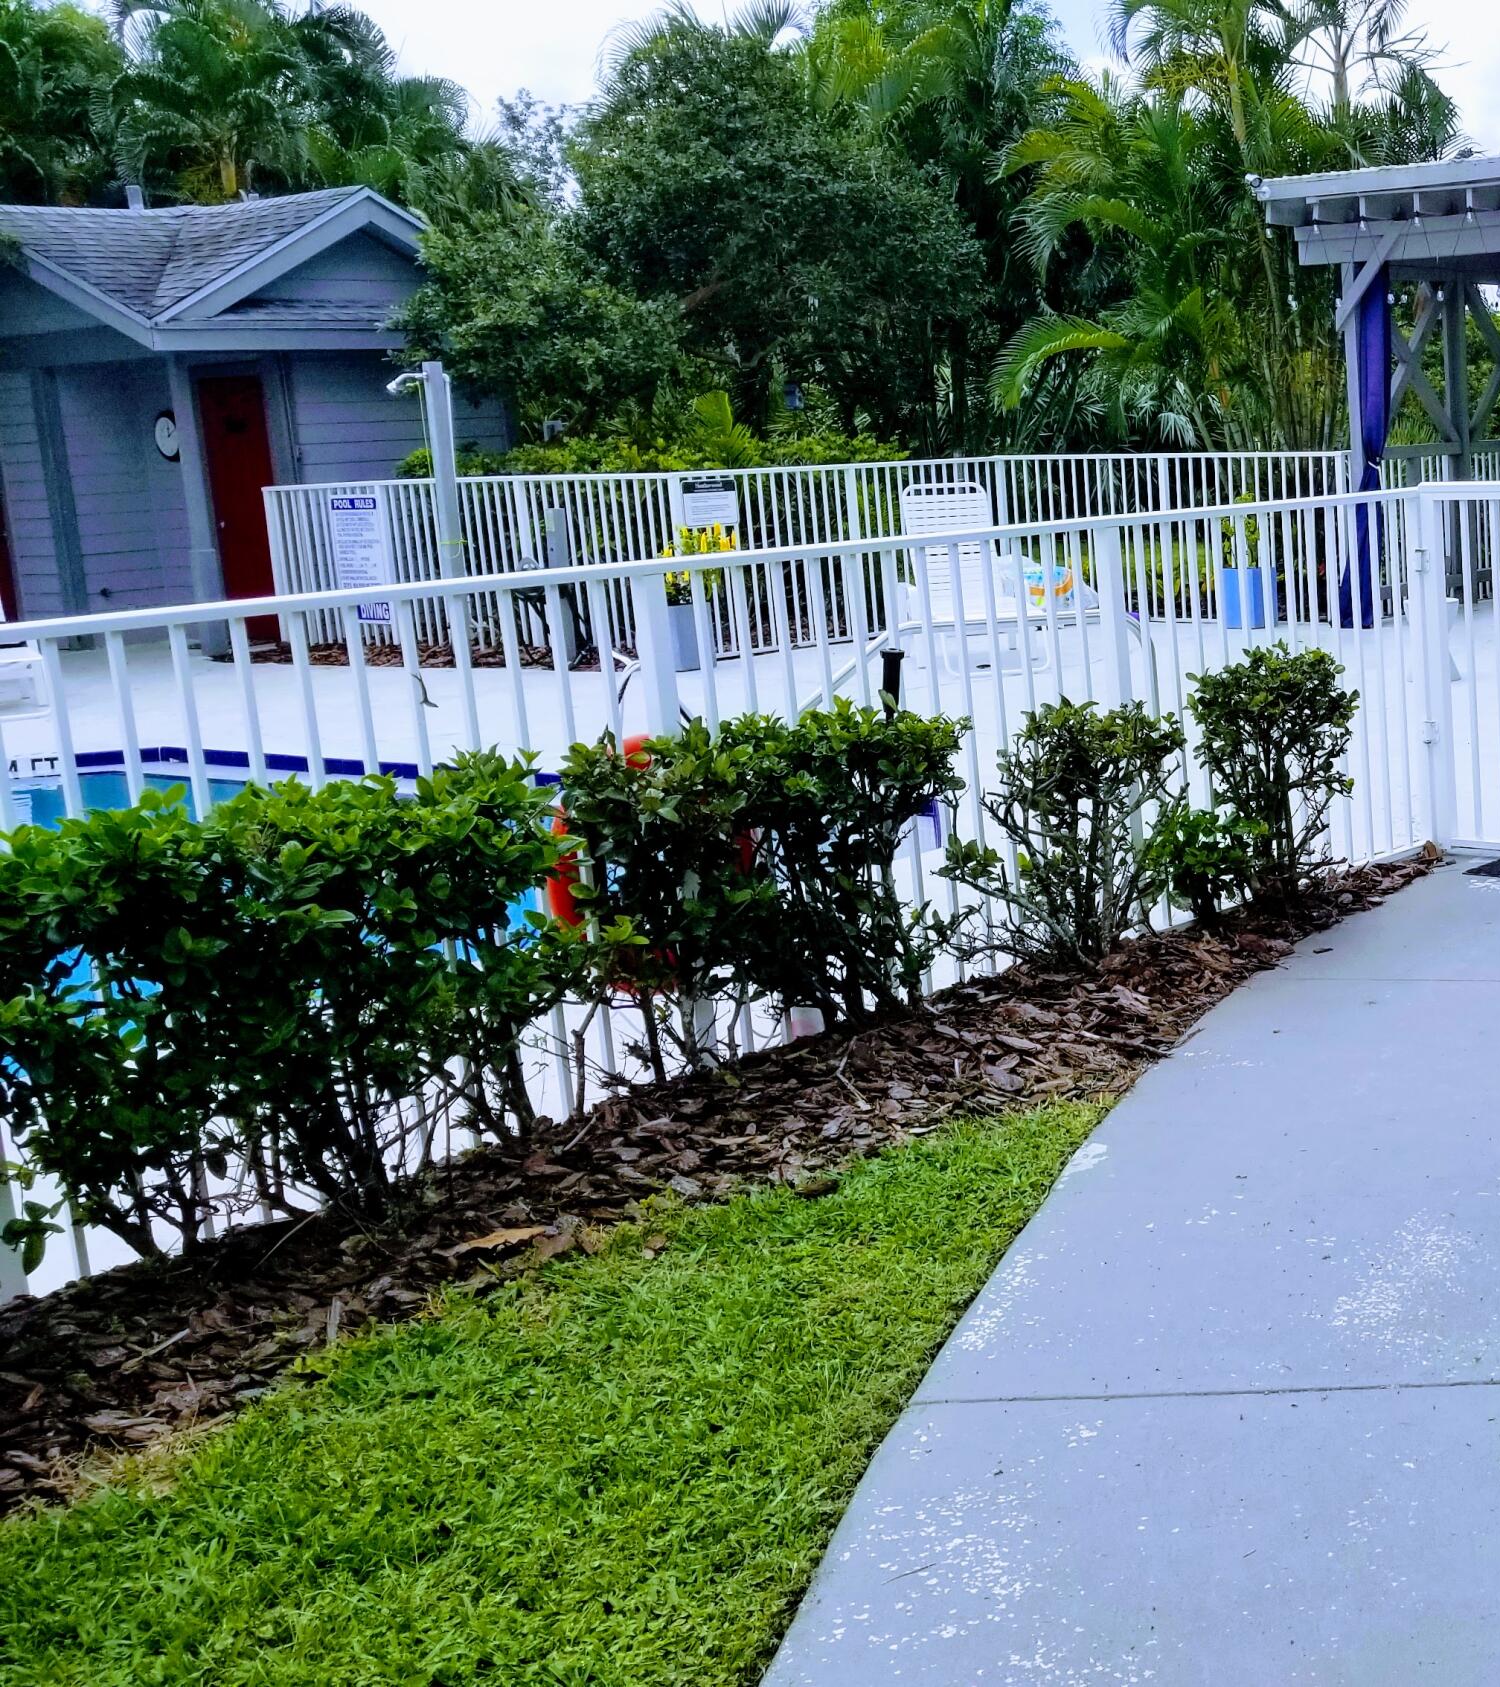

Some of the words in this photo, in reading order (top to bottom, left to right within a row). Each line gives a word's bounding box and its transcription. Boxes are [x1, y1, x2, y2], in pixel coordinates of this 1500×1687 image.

[333, 500, 351, 509] POOL
[354, 499, 374, 509] RULES
[361, 603, 390, 619] DIVING
